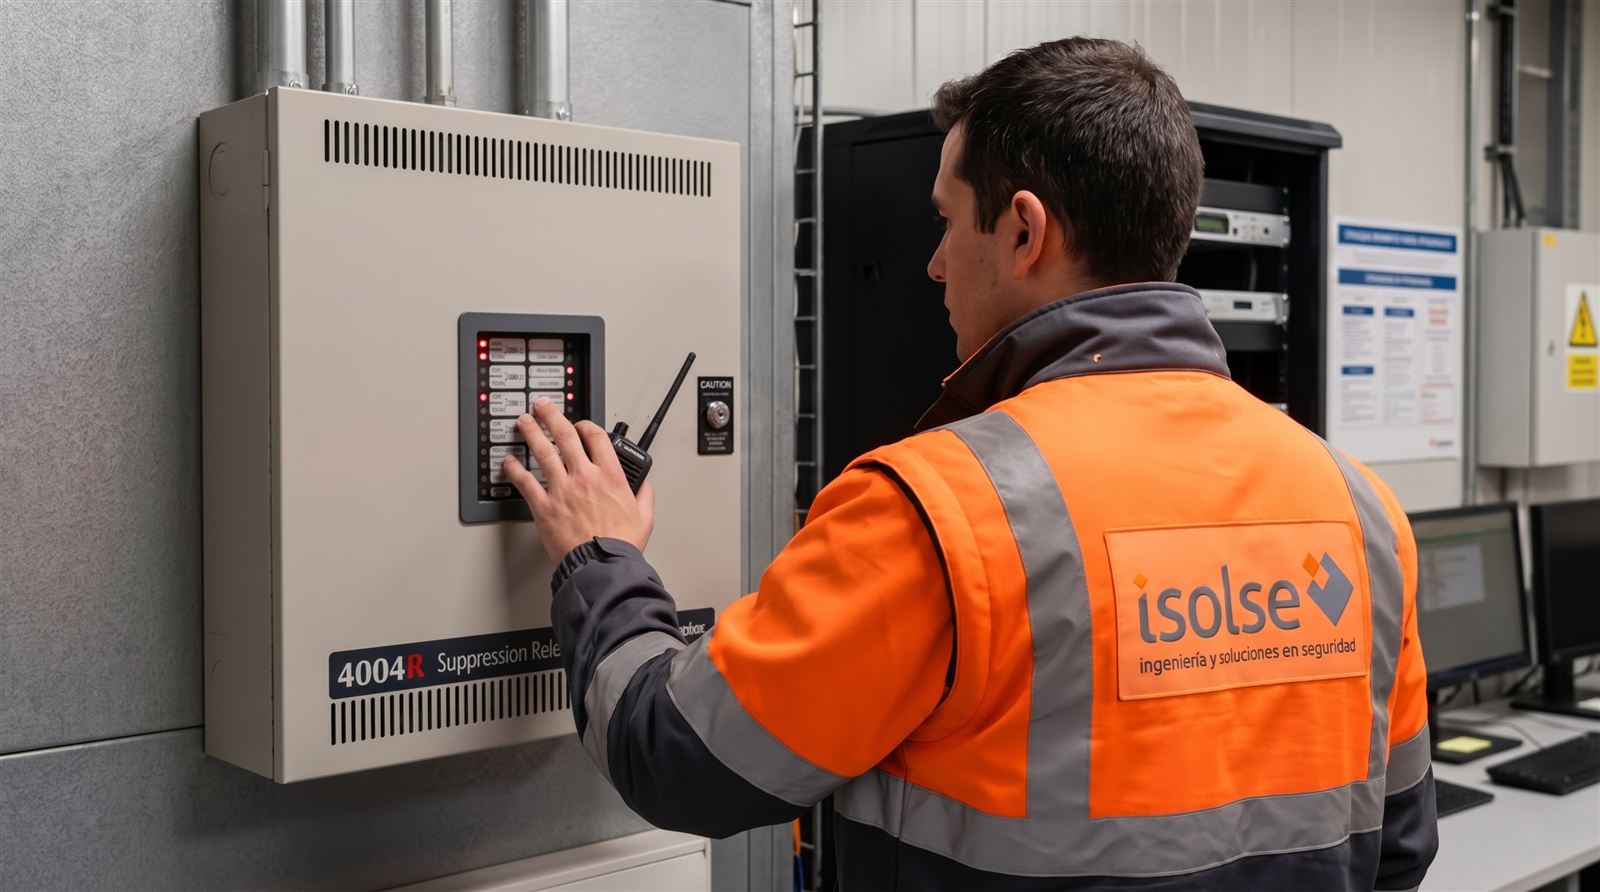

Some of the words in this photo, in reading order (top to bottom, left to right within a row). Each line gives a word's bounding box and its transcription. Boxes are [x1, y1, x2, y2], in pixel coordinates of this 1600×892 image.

[700, 380, 732, 389] CAUTION
[1132, 564, 1300, 643] isolse
[338, 652, 425, 688] 4004R
[437, 644, 527, 675] Suppression
[1139, 651, 1207, 676] ingeniería
[1209, 654, 1216, 670] y
[1219, 646, 1279, 665] soluciones
[1282, 644, 1299, 658] en
[1301, 638, 1356, 659] seguridad
